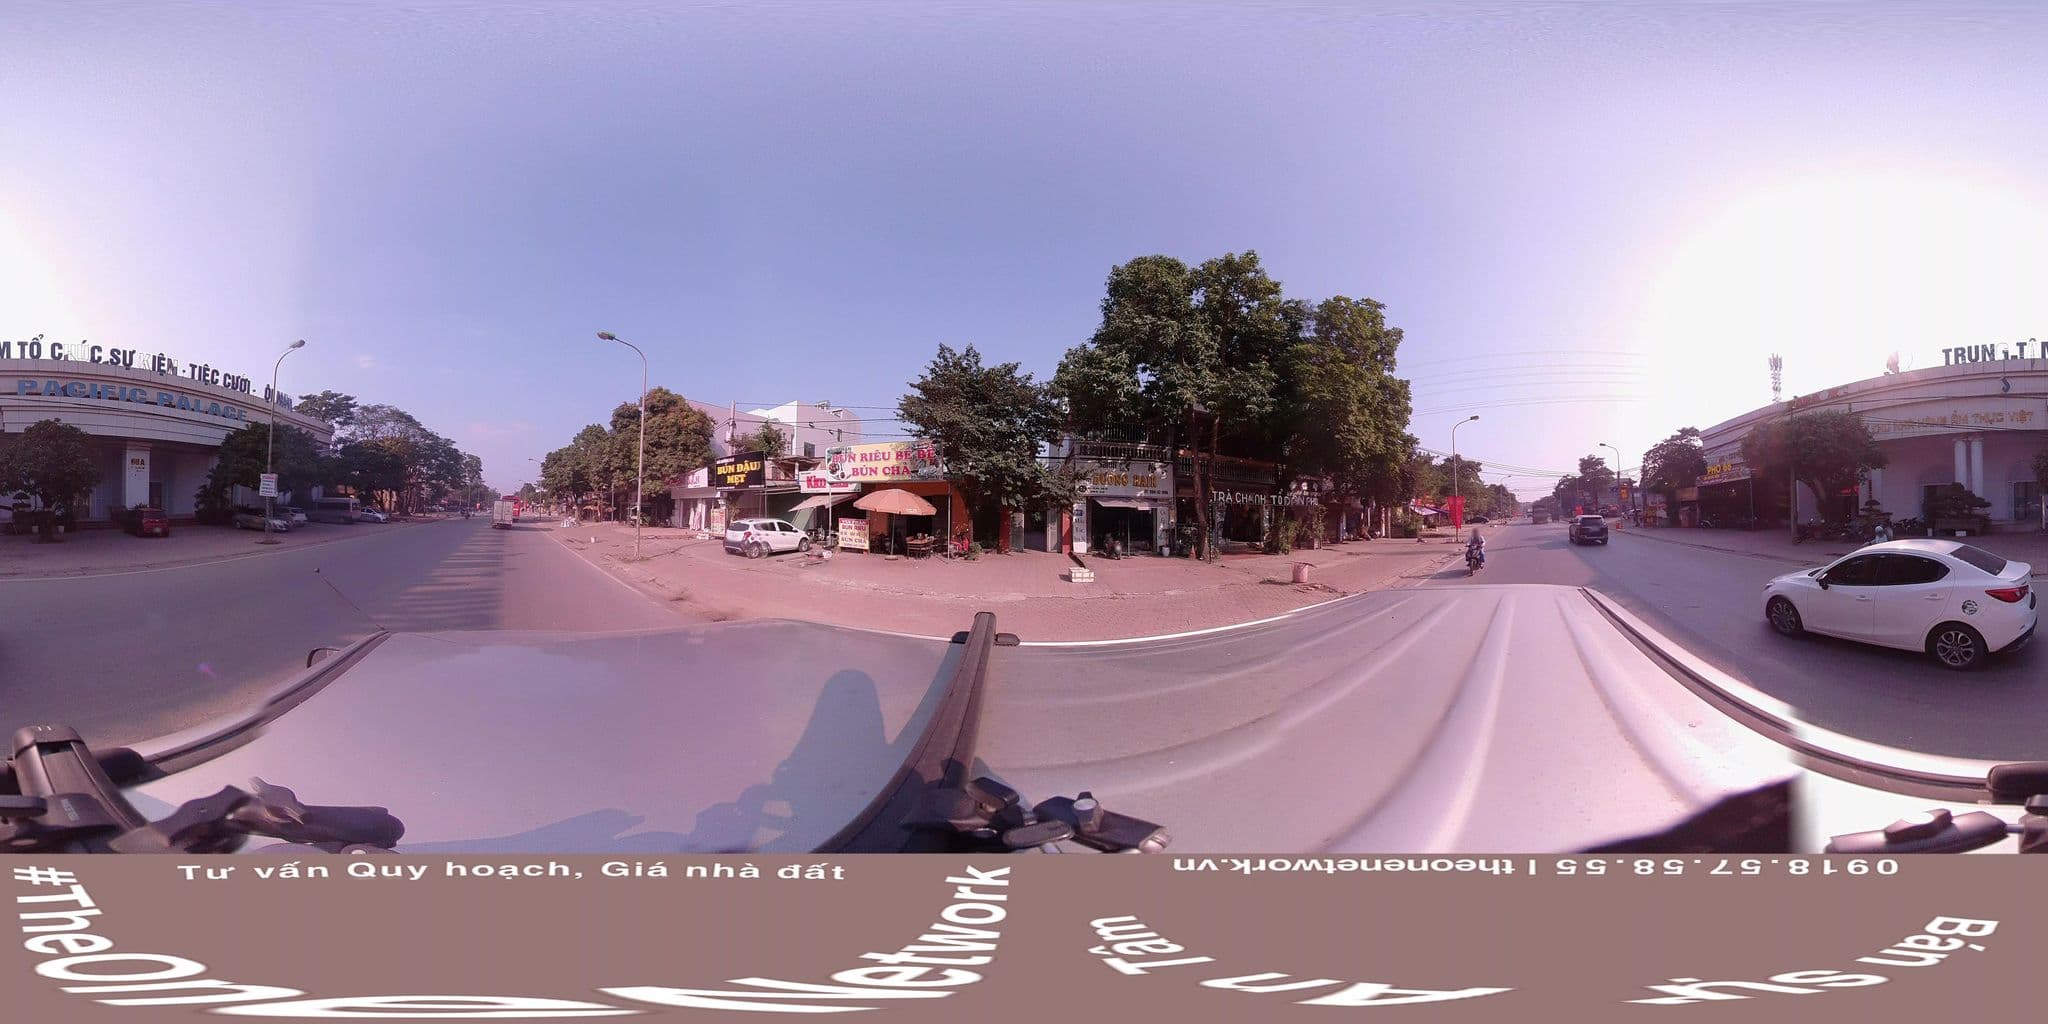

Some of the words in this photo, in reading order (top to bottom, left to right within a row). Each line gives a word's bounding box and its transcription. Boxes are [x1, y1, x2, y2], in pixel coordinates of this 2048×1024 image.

[17, 334, 44, 360] TỔ
[51, 340, 103, 363] CHỨC
[110, 348, 136, 370] SỰ
[189, 363, 220, 386] TIỆC
[1942, 343, 2009, 366] TRUNG
[17, 379, 148, 405] PACIFIC
[156, 391, 249, 421] PALACE
[852, 464, 878, 477] BÚN
[806, 475, 827, 488] Kim
[1212, 488, 1233, 503] TRÀ
